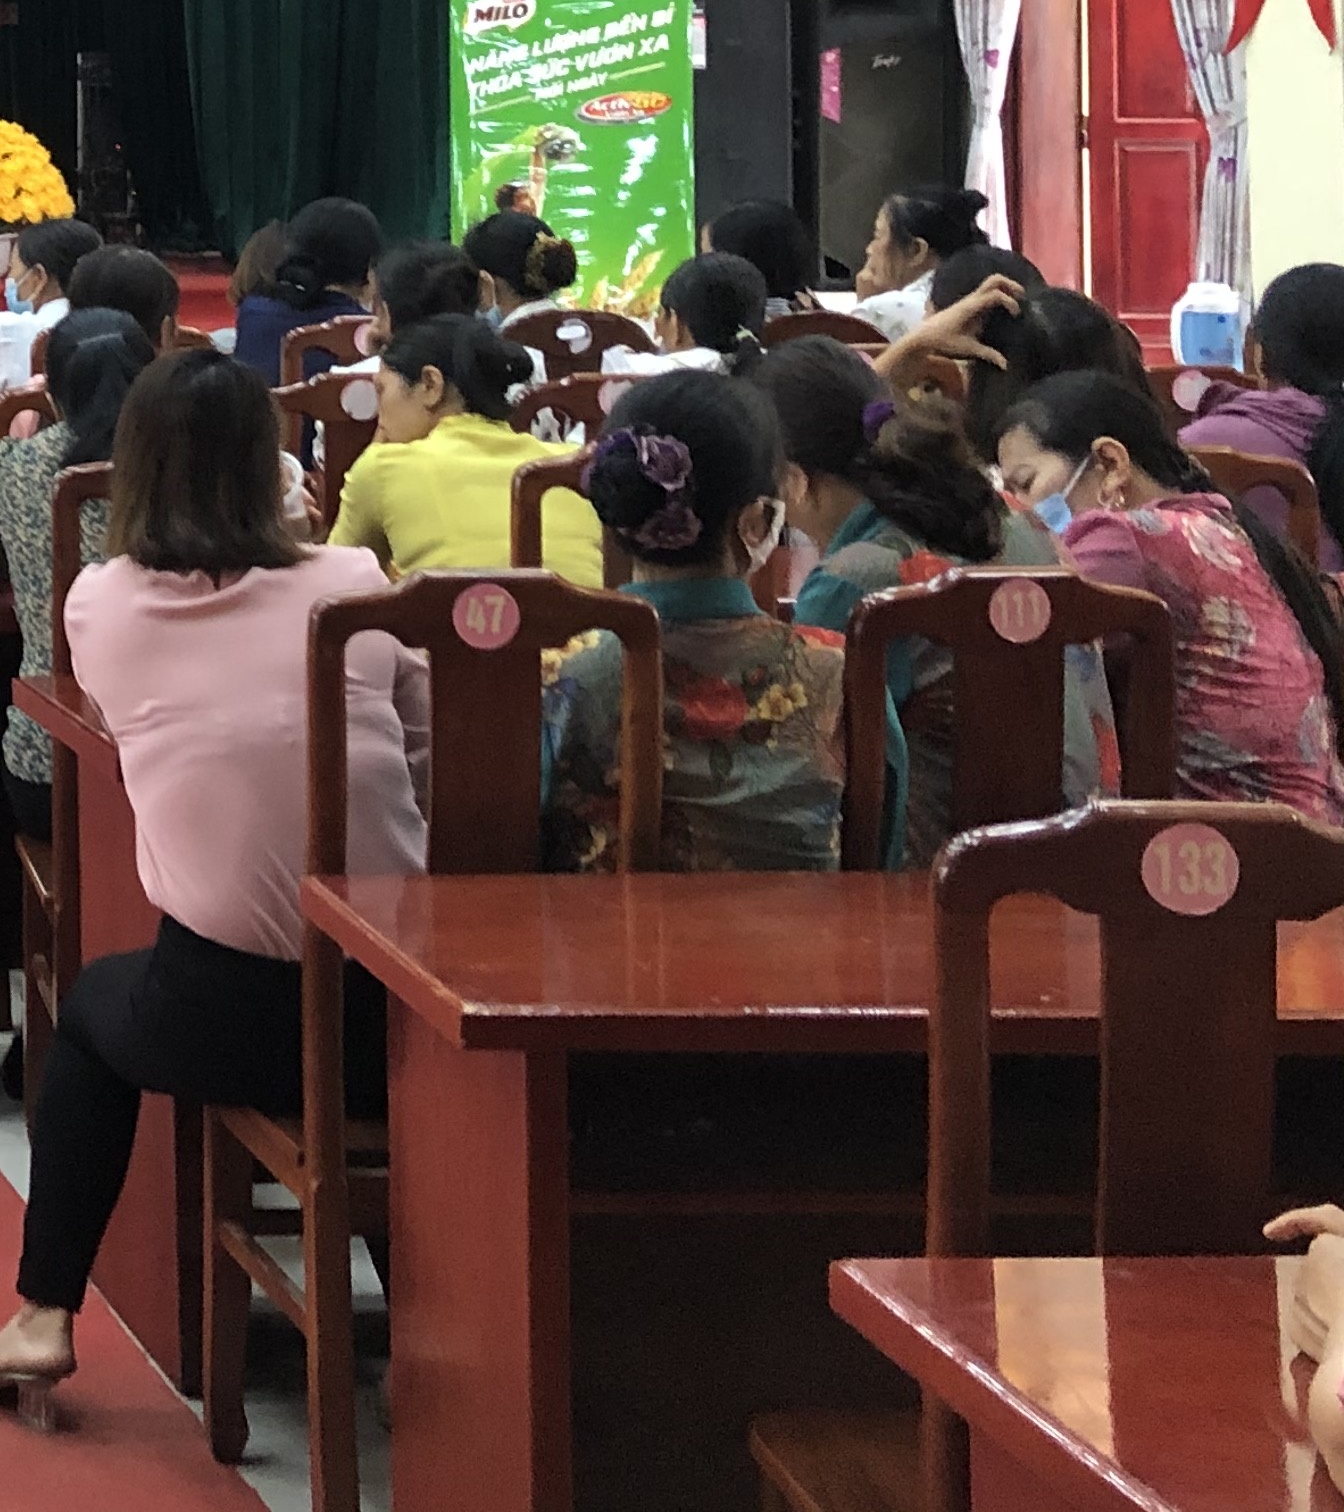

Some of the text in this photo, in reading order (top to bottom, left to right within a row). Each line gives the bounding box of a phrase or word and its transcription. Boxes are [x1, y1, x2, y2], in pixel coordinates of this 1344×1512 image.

[474, 3, 529, 23] MILO
[638, 34, 670, 56] XA
[466, 594, 506, 632] 47
[998, 593, 1041, 628] 111
[1154, 840, 1227, 896] 133
